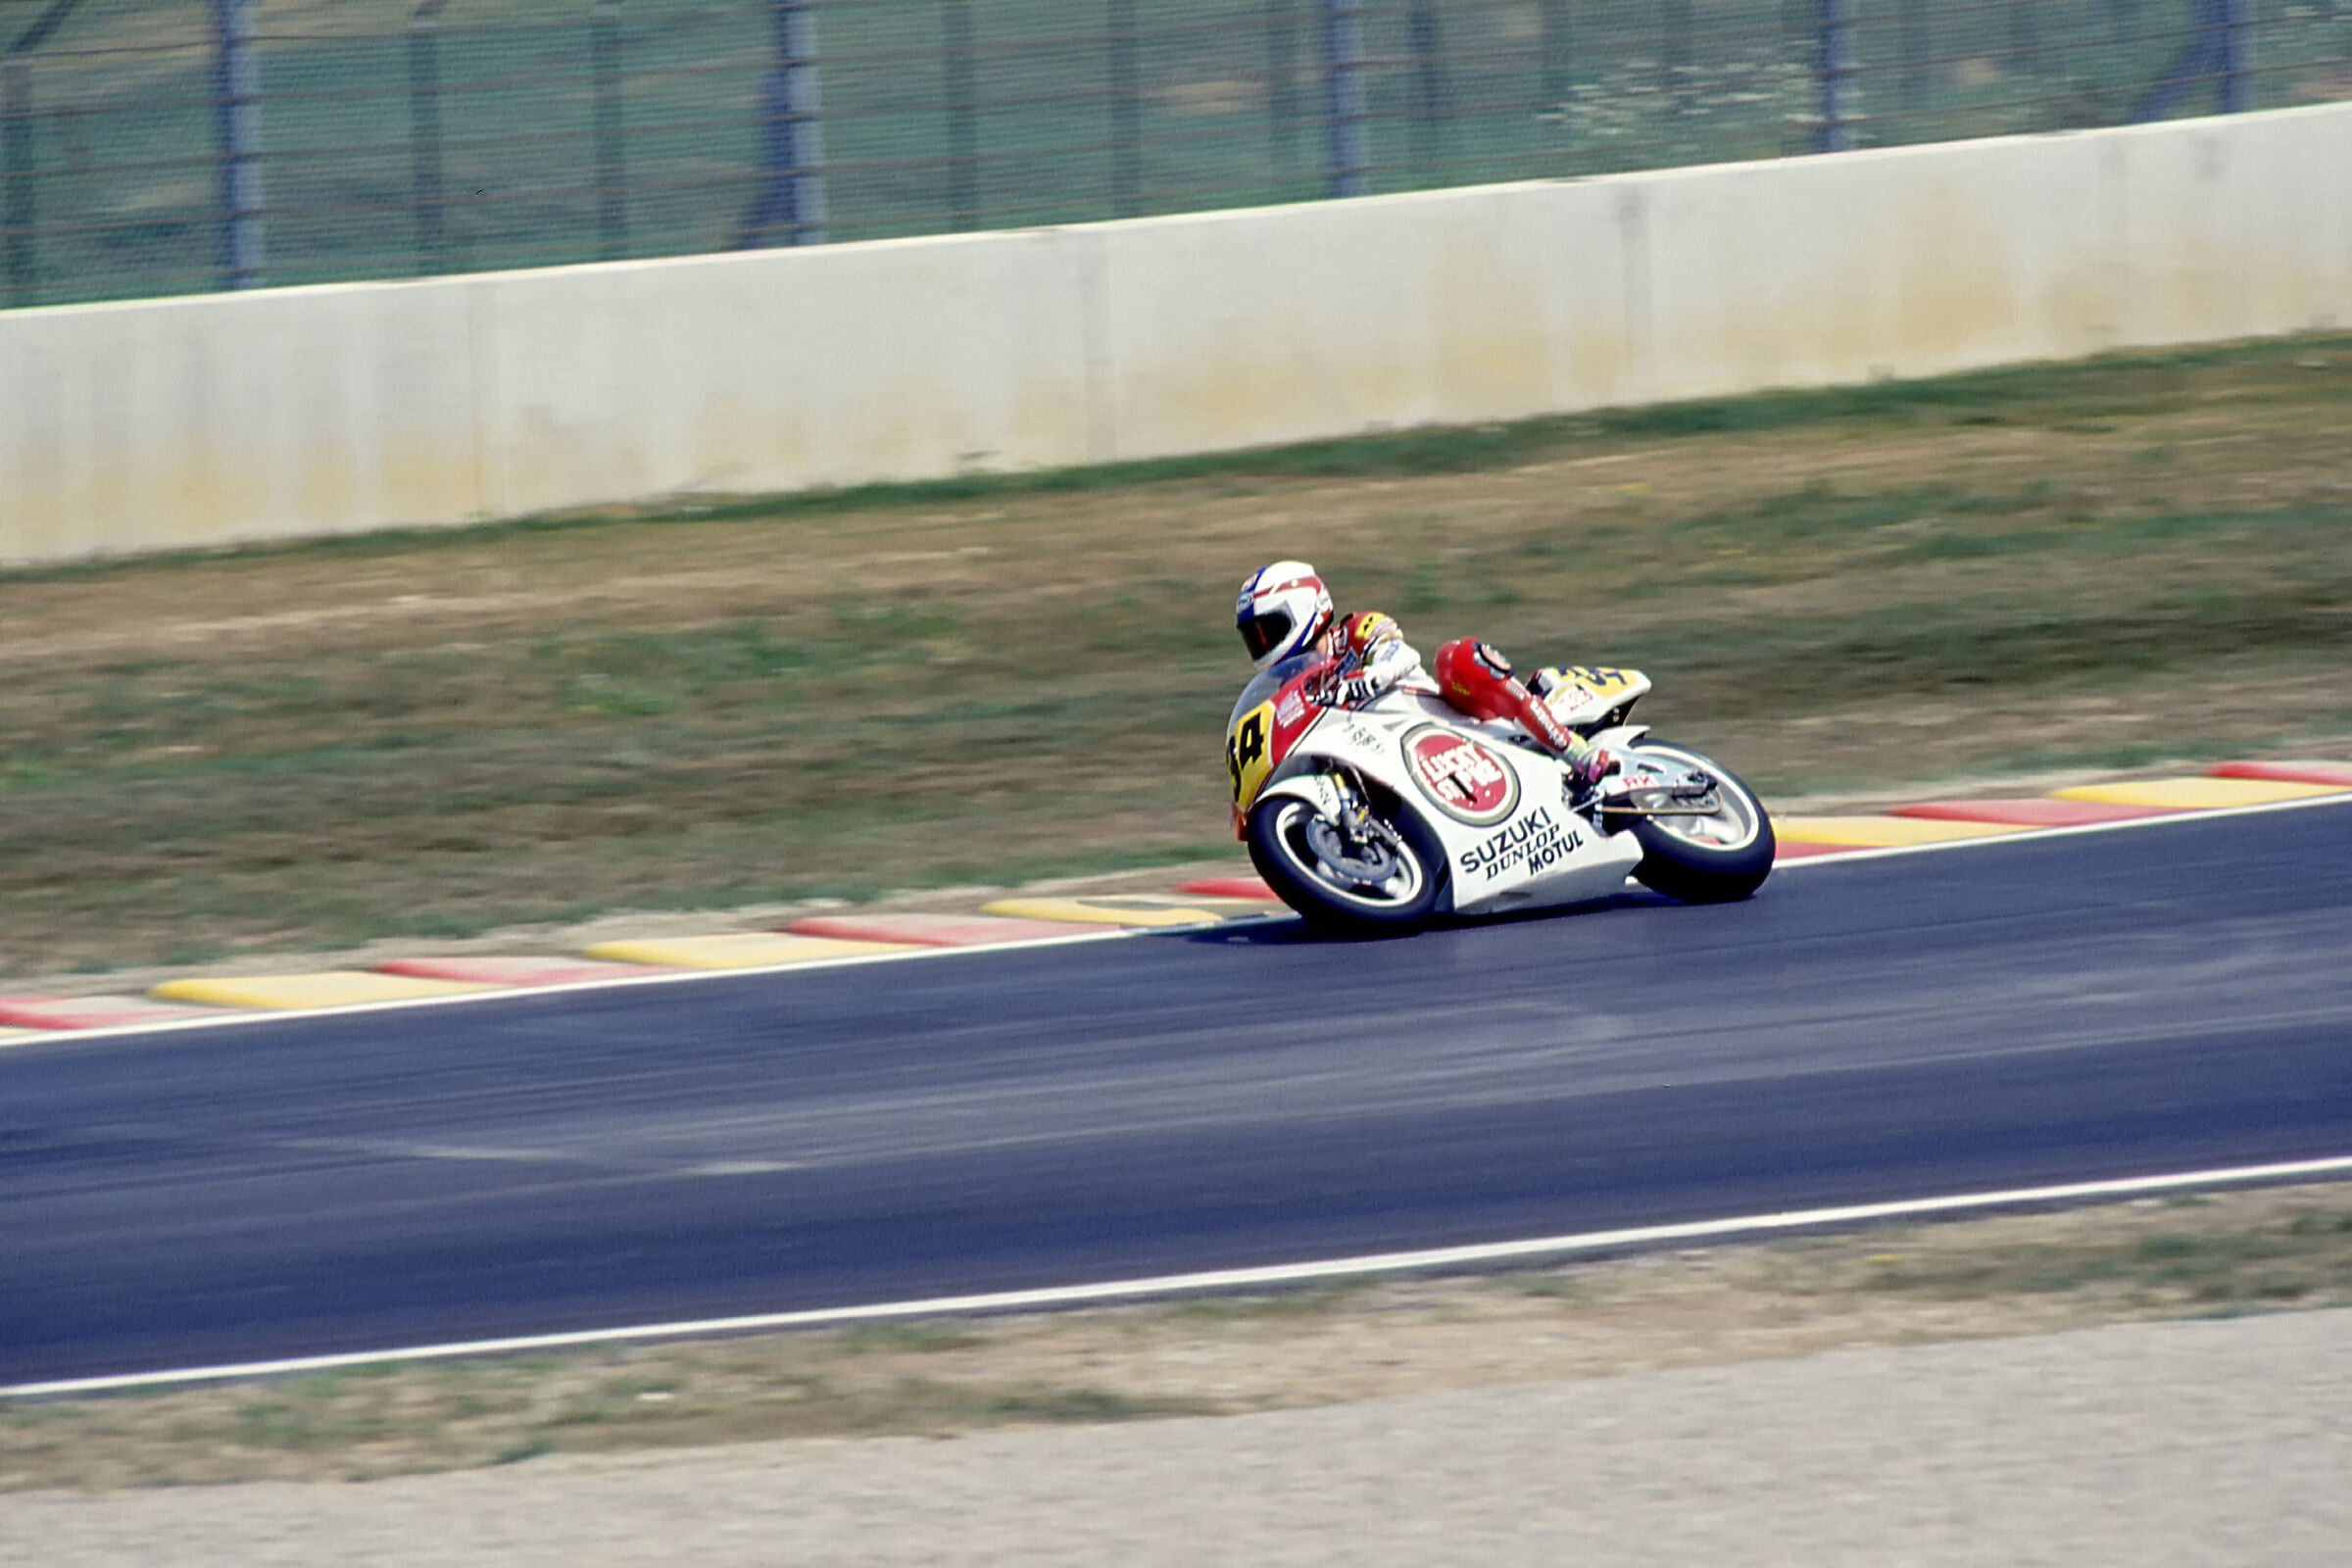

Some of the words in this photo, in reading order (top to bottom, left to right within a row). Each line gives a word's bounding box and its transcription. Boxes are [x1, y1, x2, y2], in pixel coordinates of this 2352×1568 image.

[1421, 742, 1481, 783] LUCKY
[1460, 806, 1551, 873] SUZUKI
[1486, 823, 1560, 881] DUNLOP
[1528, 830, 1584, 876] MOTUL
